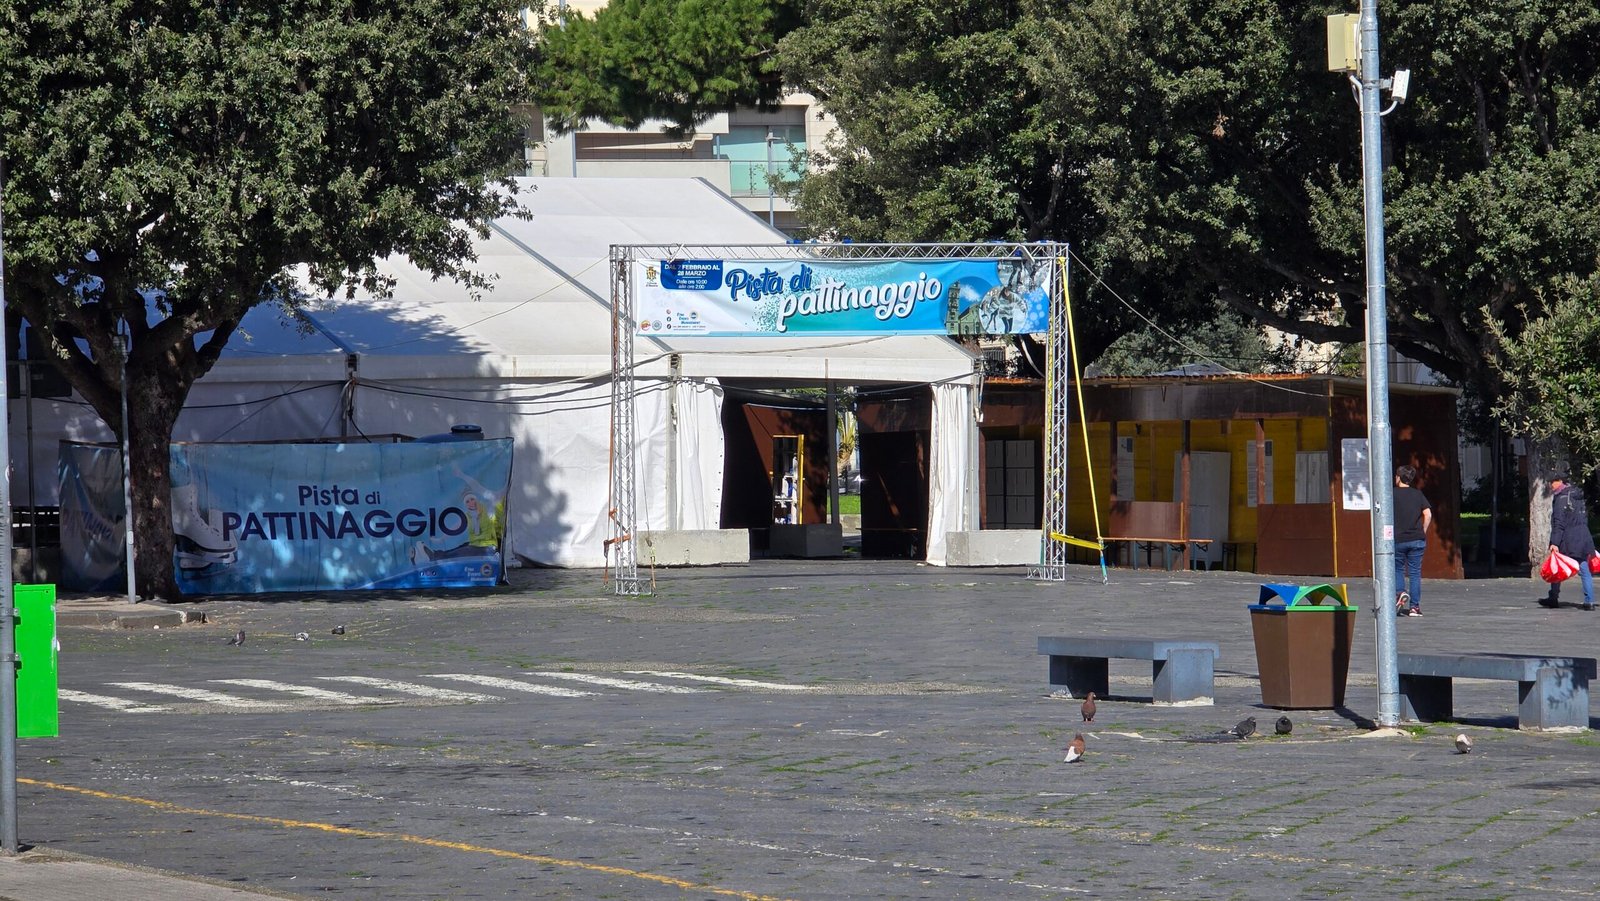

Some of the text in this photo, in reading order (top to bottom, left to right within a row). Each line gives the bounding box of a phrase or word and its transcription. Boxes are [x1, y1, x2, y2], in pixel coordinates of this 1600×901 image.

[725, 264, 813, 301] Pista di
[776, 272, 944, 332] pattinaggio
[298, 484, 380, 506] Pista di
[222, 506, 468, 542] PATTINAGGIO
